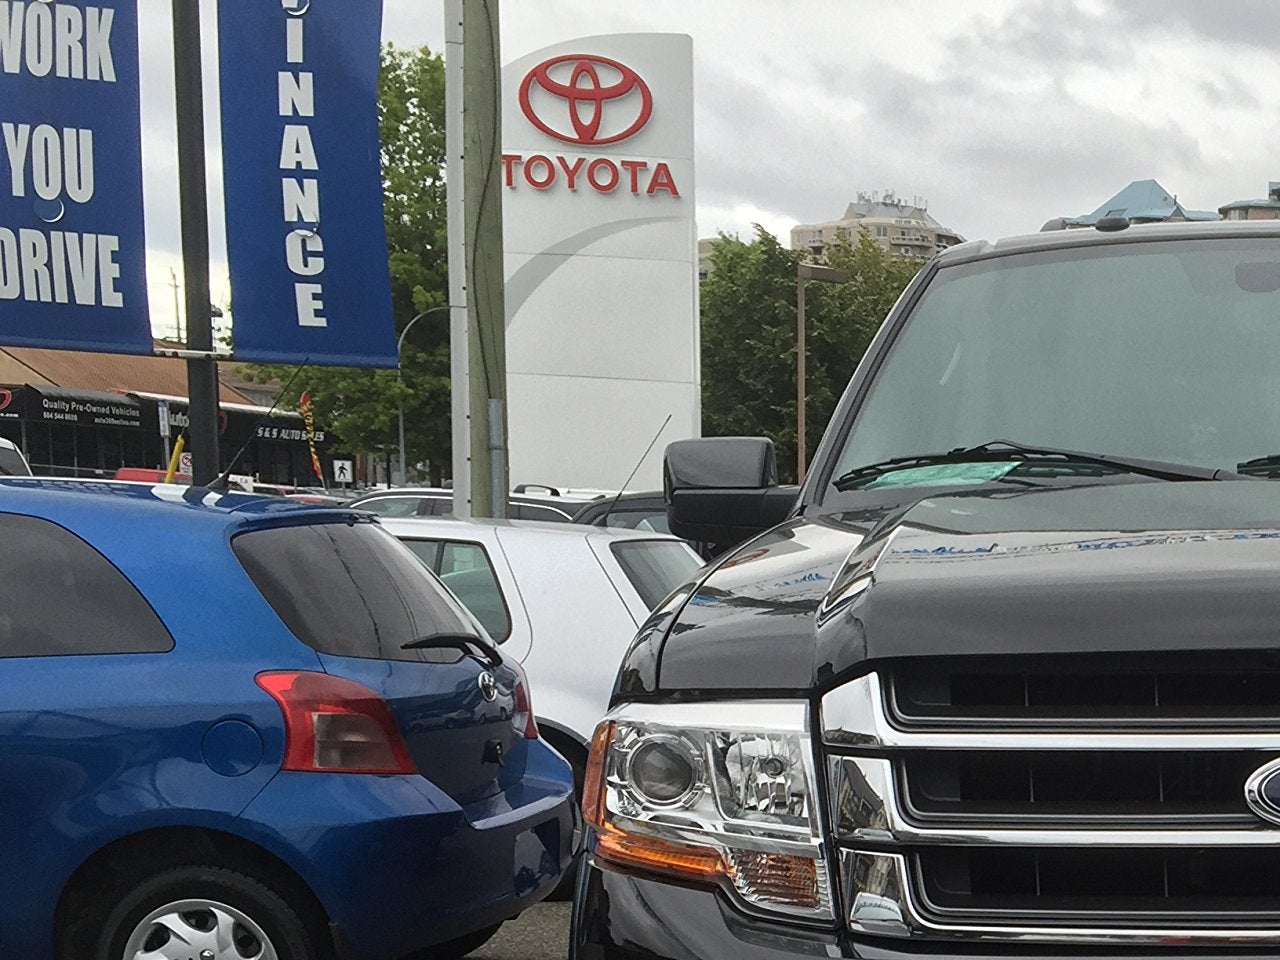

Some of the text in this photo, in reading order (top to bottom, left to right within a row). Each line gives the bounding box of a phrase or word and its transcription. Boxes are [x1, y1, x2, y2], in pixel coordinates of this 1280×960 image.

[0, 1, 117, 82] WORK
[2, 122, 95, 204] YOU
[276, 0, 328, 327] INANCE
[501, 154, 680, 198] TOYOTA
[0, 227, 124, 308] DRIVE
[42, 399, 140, 417] Quality Pre-Owned Vehicles
[257, 427, 325, 441] S & S AUTO SLES
